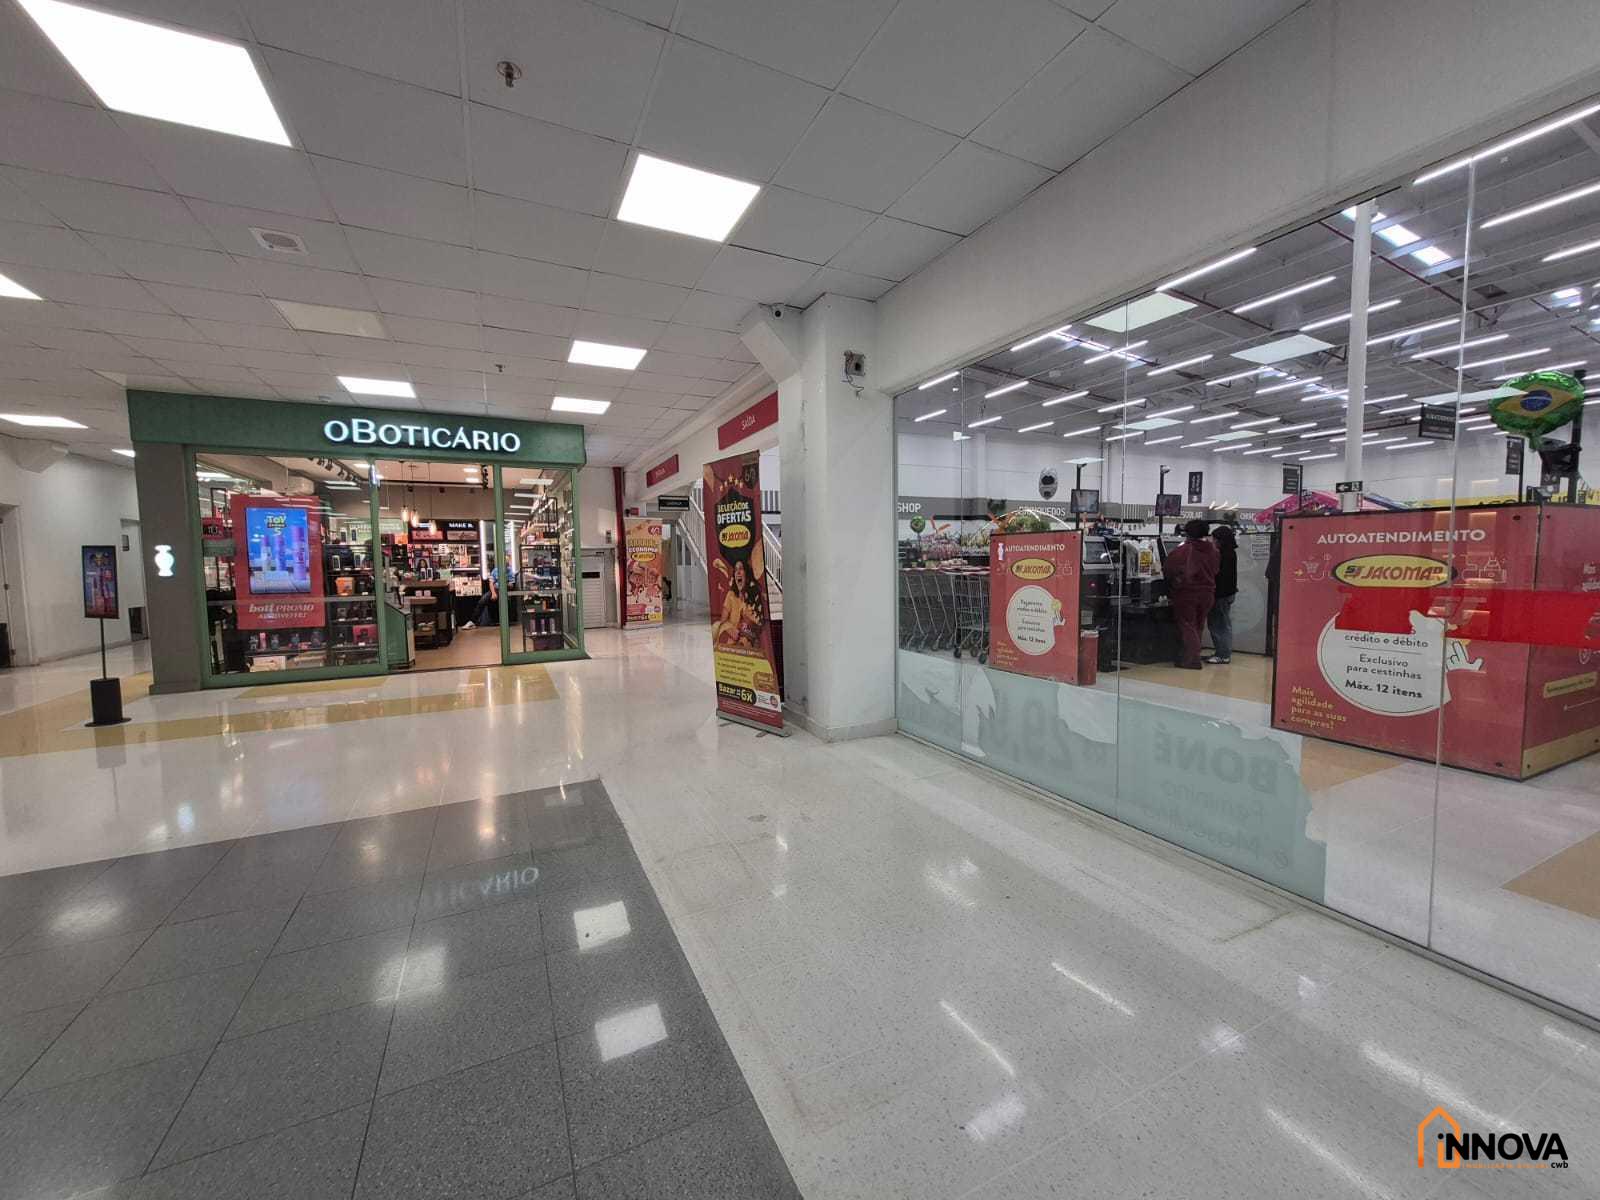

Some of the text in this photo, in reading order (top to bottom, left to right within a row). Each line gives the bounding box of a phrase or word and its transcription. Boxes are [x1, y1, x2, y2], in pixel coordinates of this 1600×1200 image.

[717, 510, 752, 525] OFERTAS
[1316, 528, 1487, 545] AUTOATENDIMENTO
[1344, 632, 1381, 644] crédito
[1392, 635, 1429, 648] débito
[1359, 653, 1409, 668] Exclusivo
[1346, 664, 1422, 681] para cestinhas
[1291, 685, 1315, 697] Mais
[1344, 679, 1423, 699] Máx. 12 itens
[1291, 697, 1335, 711] agilidade
[1291, 706, 1347, 722] para as suas
[1290, 715, 1335, 730] compras!
